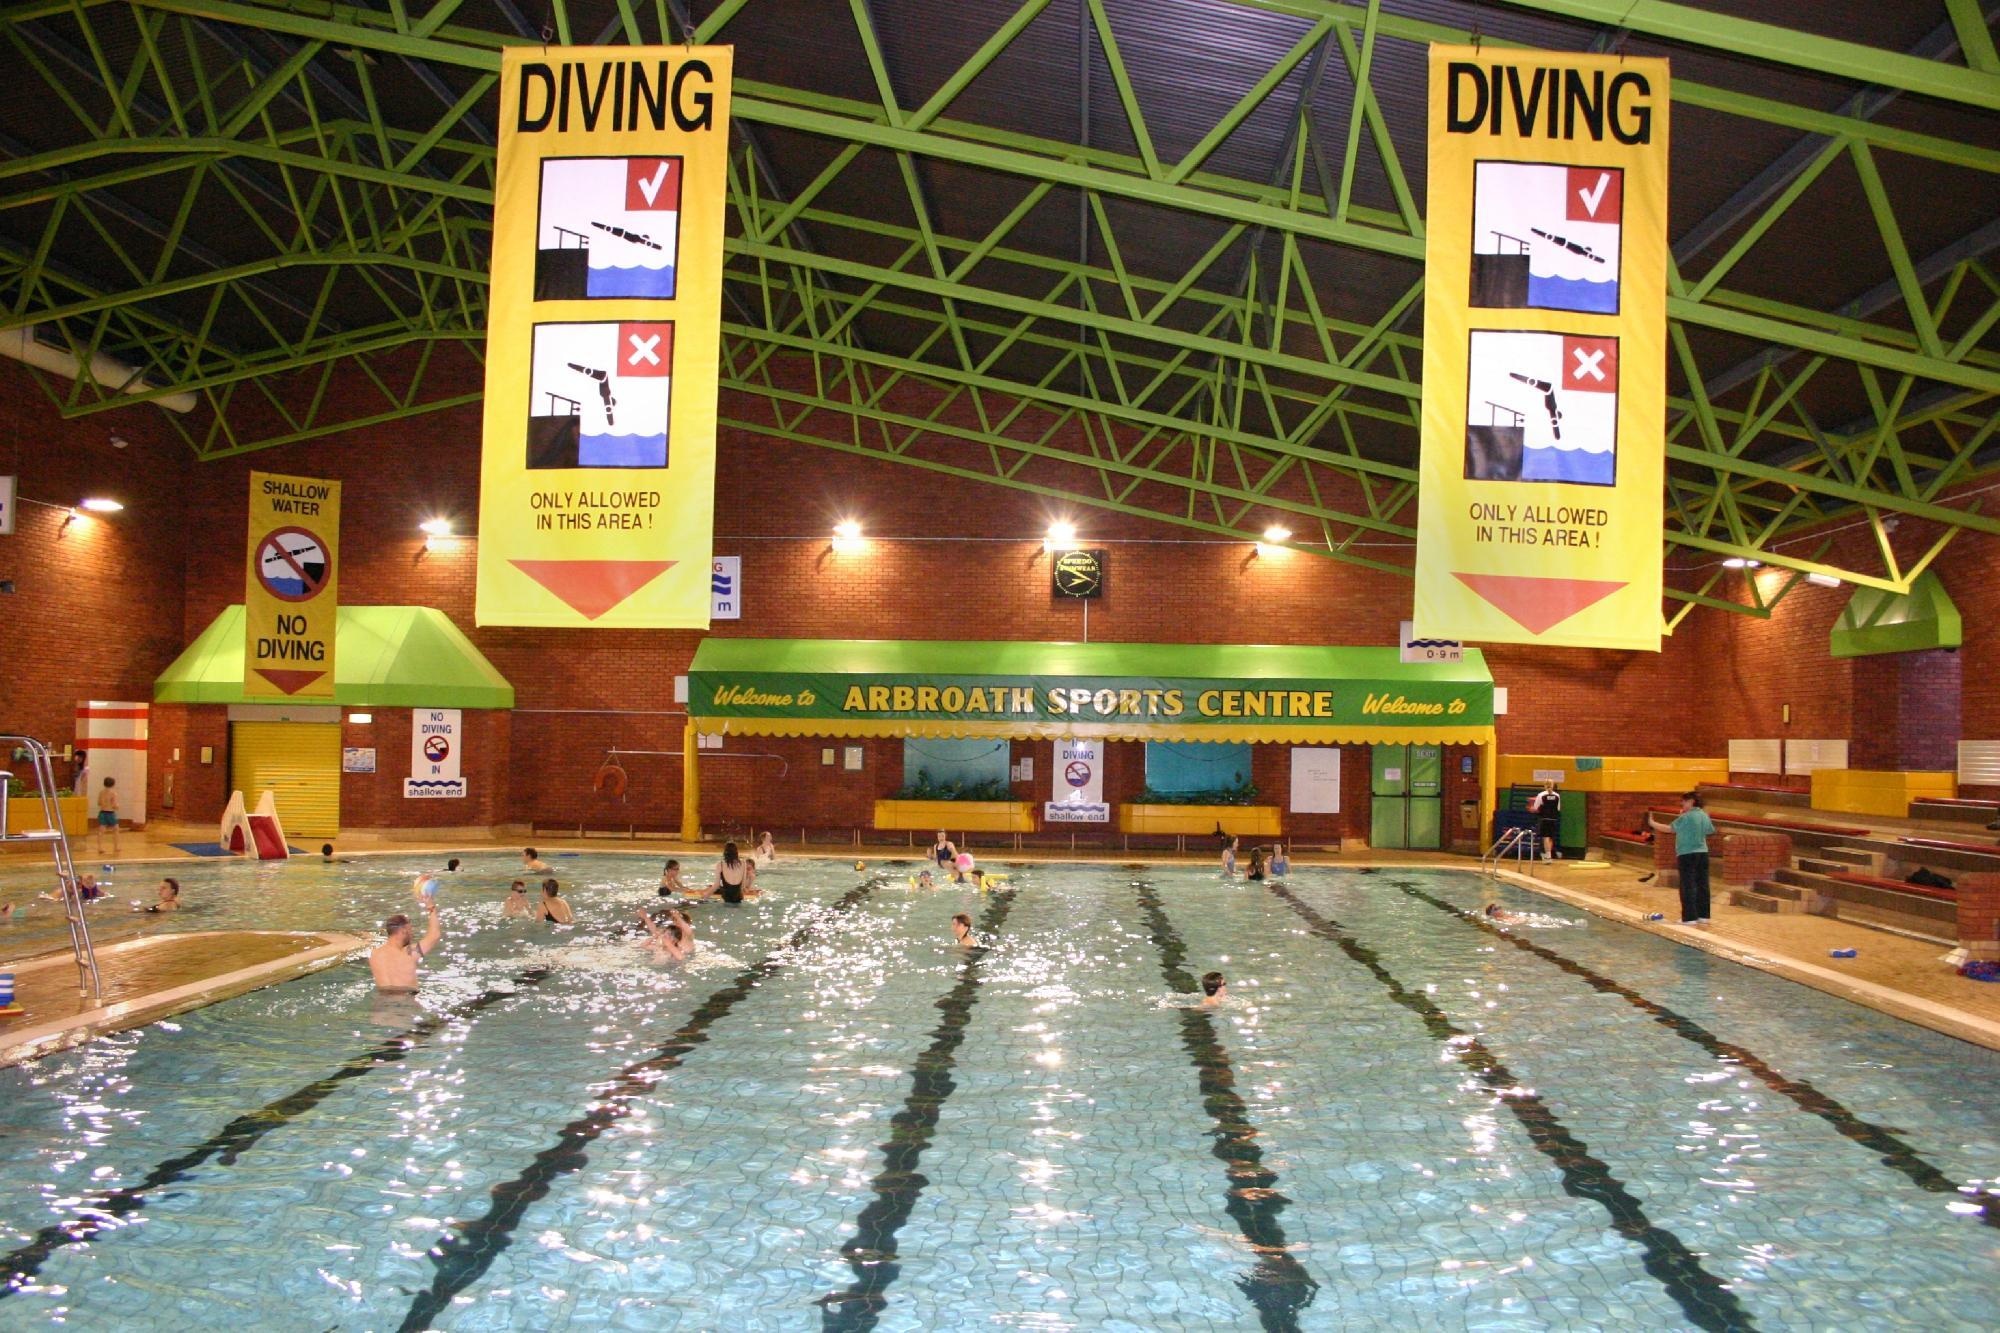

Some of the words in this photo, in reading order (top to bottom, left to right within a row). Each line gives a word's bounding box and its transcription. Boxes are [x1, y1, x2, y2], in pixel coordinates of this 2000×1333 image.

[517, 59, 713, 133] DIVING
[1446, 62, 1651, 145] DIVING
[263, 480, 329, 500] SHALLOW
[272, 498, 320, 516] WATER
[530, 492, 573, 509] ONLY
[578, 491, 660, 509] ALLOWED
[537, 513, 552, 530] IN
[557, 512, 592, 530] THIS
[597, 513, 642, 530] AREA
[1469, 502, 1517, 522] ONLY
[1523, 505, 1608, 527] ALLOWED
[1476, 526, 1493, 542] IN
[1498, 526, 1538, 545] THIS
[1542, 528, 1590, 548] AREA
[718, 602, 731, 611] m
[277, 614, 308, 636] NO
[257, 638, 325, 661] DIVING
[1449, 651, 1459, 659] m
[712, 684, 794, 706] Welcome
[797, 689, 816, 706] to
[841, 685, 1035, 713] ARBROATH
[1046, 687, 1185, 717] SPORTS
[1197, 689, 1335, 718] CENTRE
[1362, 692, 1443, 715] Welcome
[1448, 697, 1467, 715] to
[431, 712, 443, 721] NO
[422, 725, 451, 733] DIVING
[1063, 751, 1094, 759] DIVING
[432, 766, 440, 774] IN
[408, 788, 442, 796] shallow
[446, 788, 462, 796] end
[1049, 812, 1083, 820] shallow
